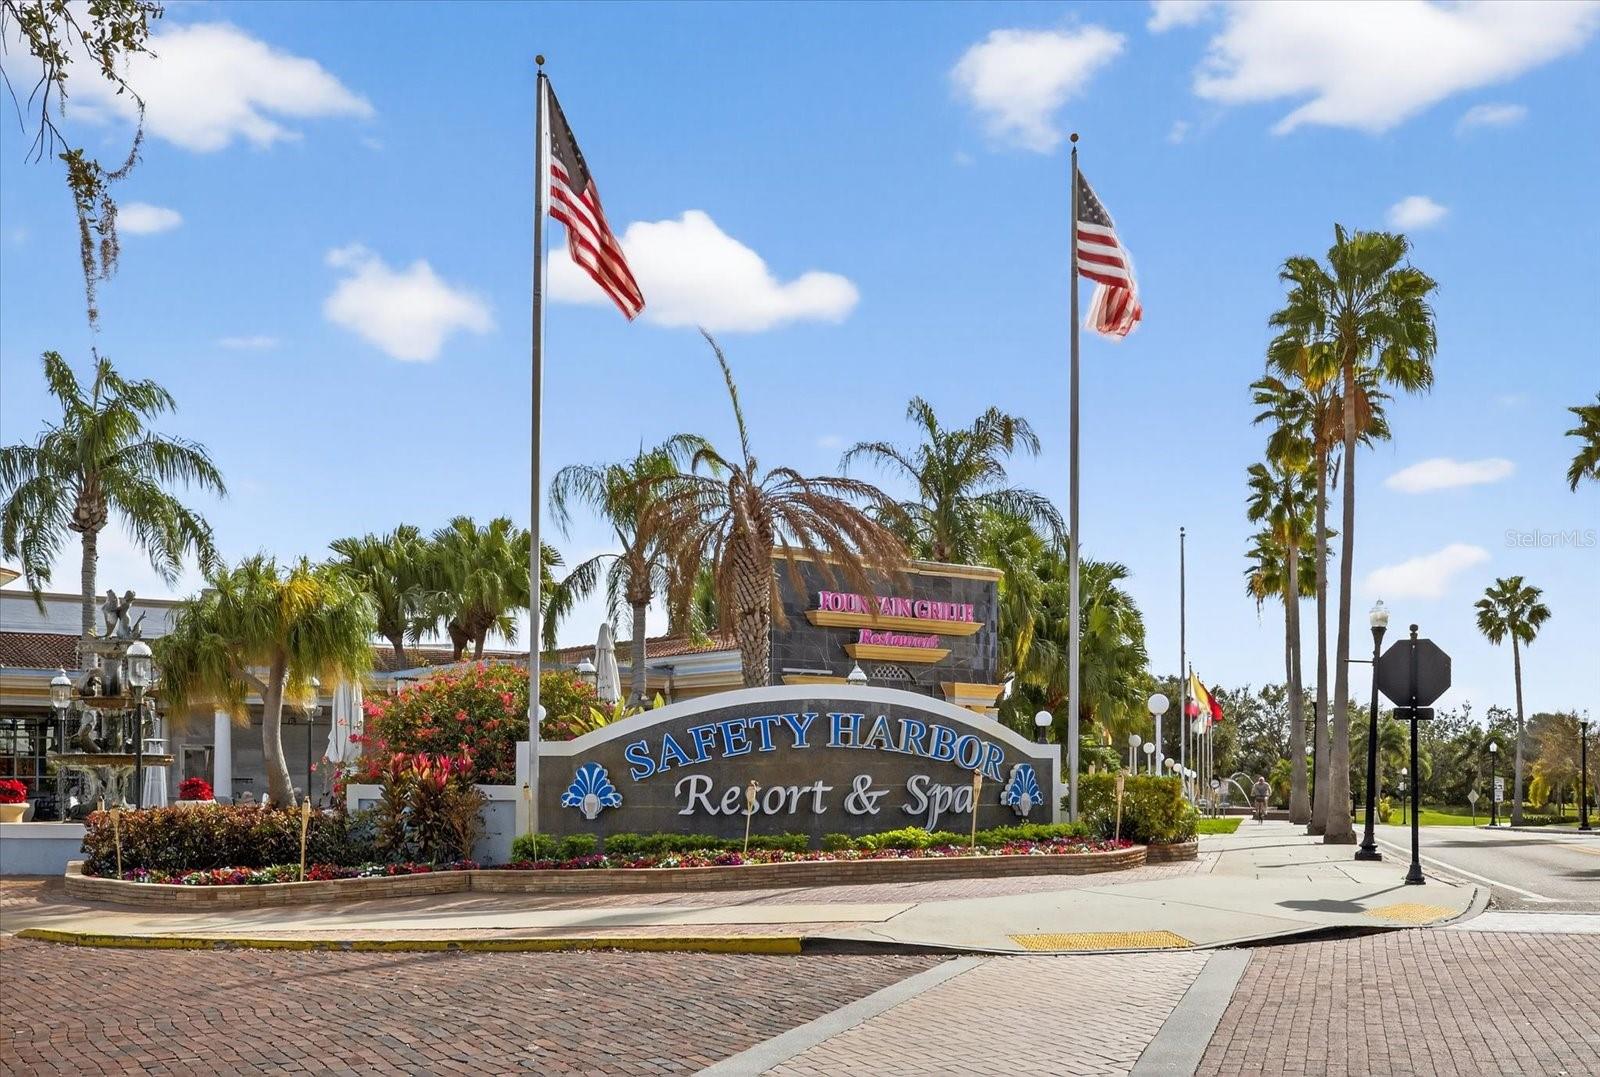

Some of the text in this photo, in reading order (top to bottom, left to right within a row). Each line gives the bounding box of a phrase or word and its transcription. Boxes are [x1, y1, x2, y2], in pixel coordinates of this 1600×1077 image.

[818, 590, 974, 622] FOUNAIN GRILLE
[858, 628, 940, 649] Restaurant
[624, 712, 1005, 783] SAFETY HARBOR
[844, 774, 890, 816] &
[902, 774, 975, 832] Spa
